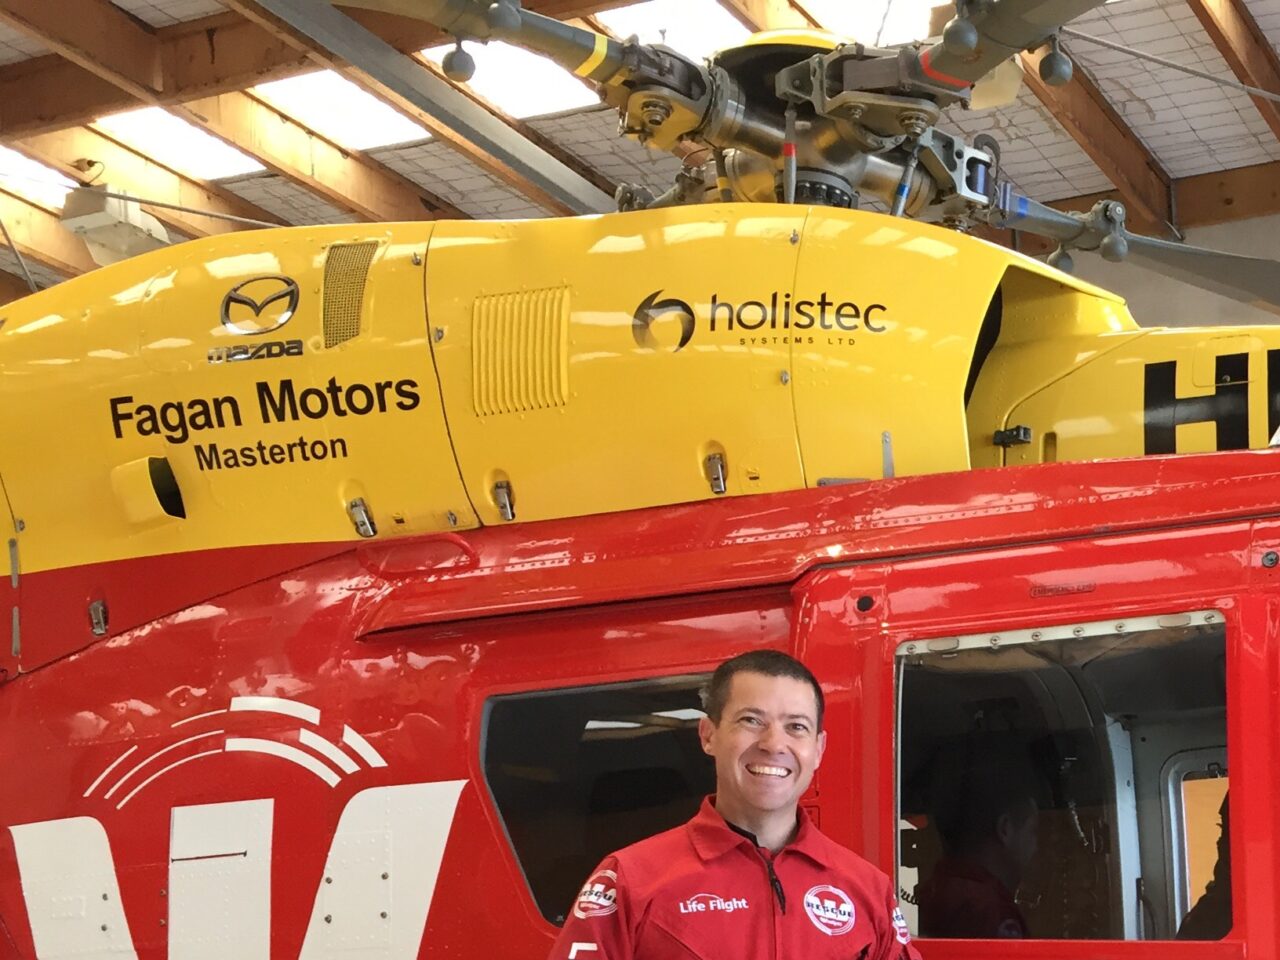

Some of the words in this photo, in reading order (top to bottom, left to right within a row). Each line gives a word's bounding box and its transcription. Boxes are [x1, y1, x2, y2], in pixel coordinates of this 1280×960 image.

[710, 291, 888, 333] holistec
[739, 336, 815, 346] SYSTEMS
[828, 337, 856, 346] LTD
[109, 395, 243, 444] Fagan
[255, 375, 421, 424] Motors
[193, 435, 349, 471] Masterton
[679, 899, 706, 914] Life
[709, 897, 749, 914] Flight
